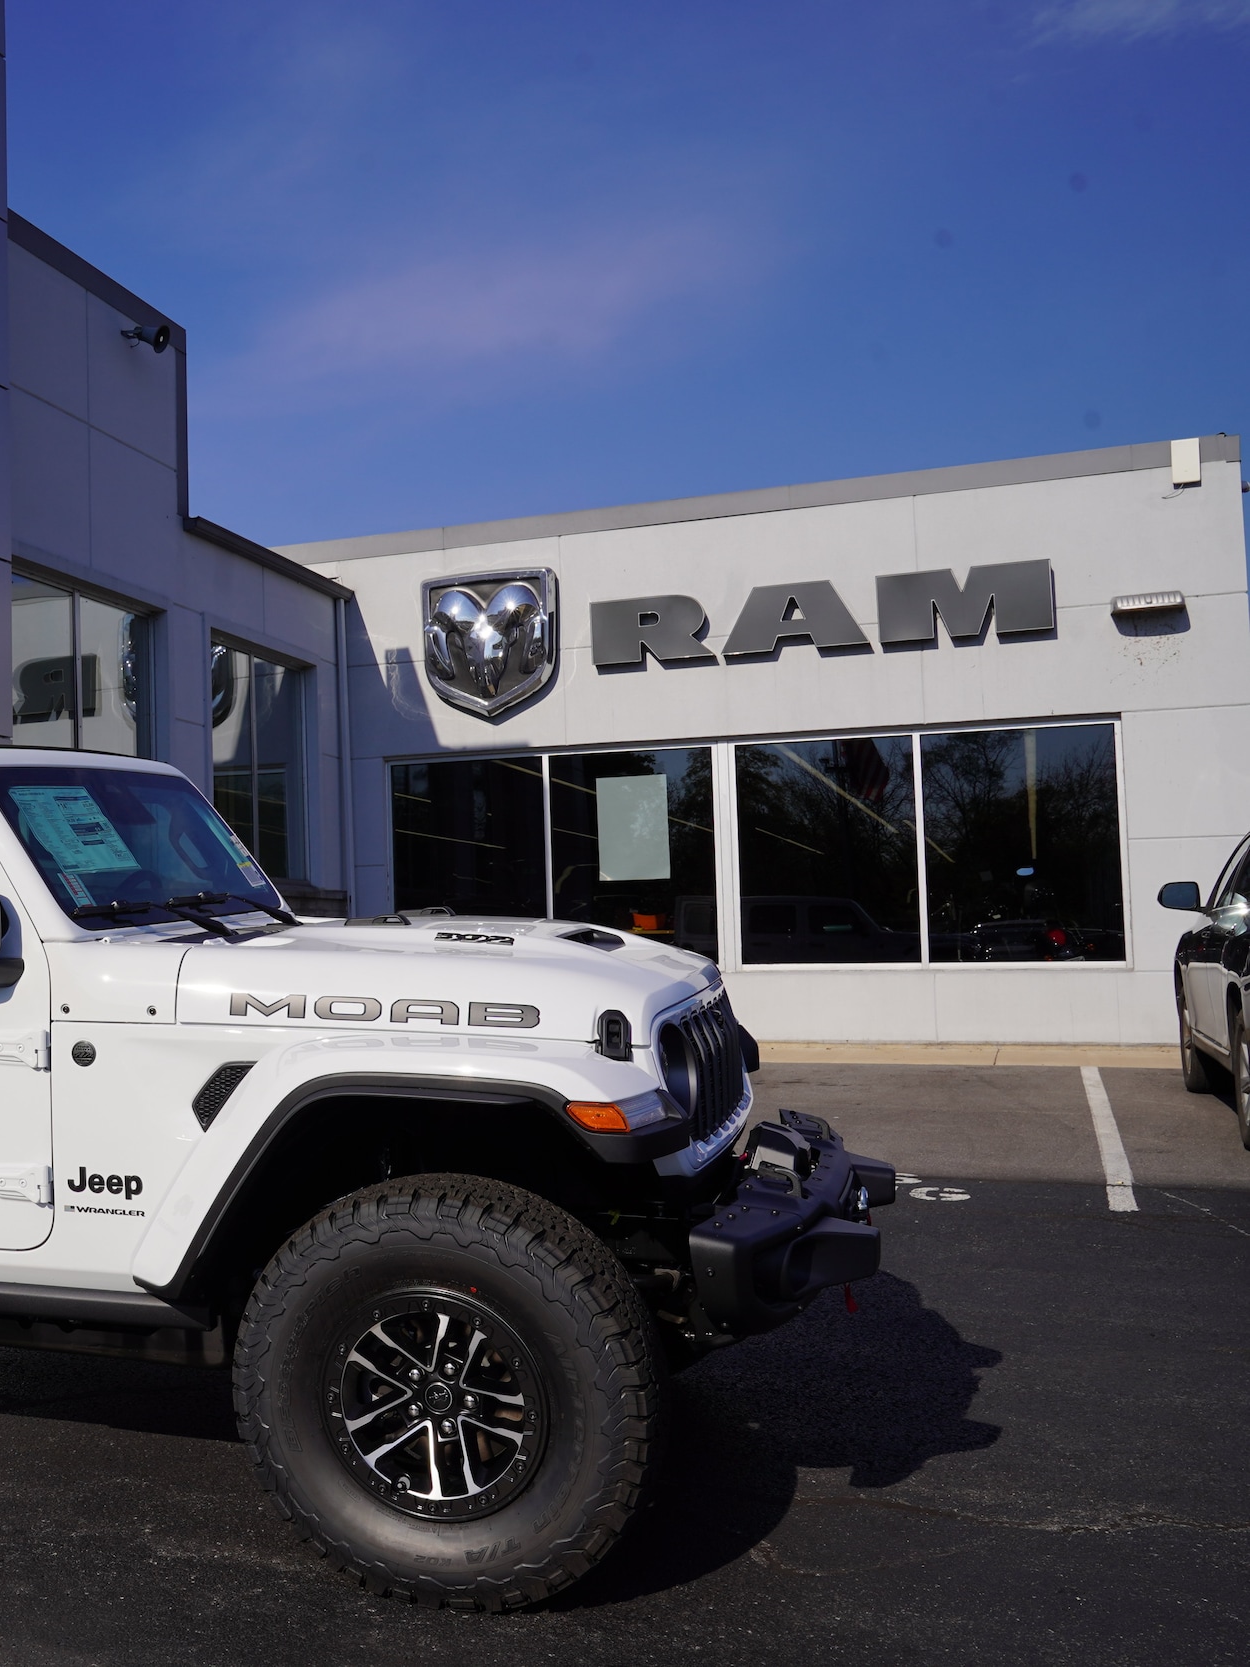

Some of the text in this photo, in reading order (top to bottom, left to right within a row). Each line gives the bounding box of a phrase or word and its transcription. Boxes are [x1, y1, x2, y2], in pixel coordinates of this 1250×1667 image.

[590, 558, 1056, 672] RAM
[434, 932, 515, 946] 392
[229, 992, 541, 1029] MOAB
[67, 1166, 144, 1201] Jeep
[76, 1205, 146, 1217] WRANGLER
